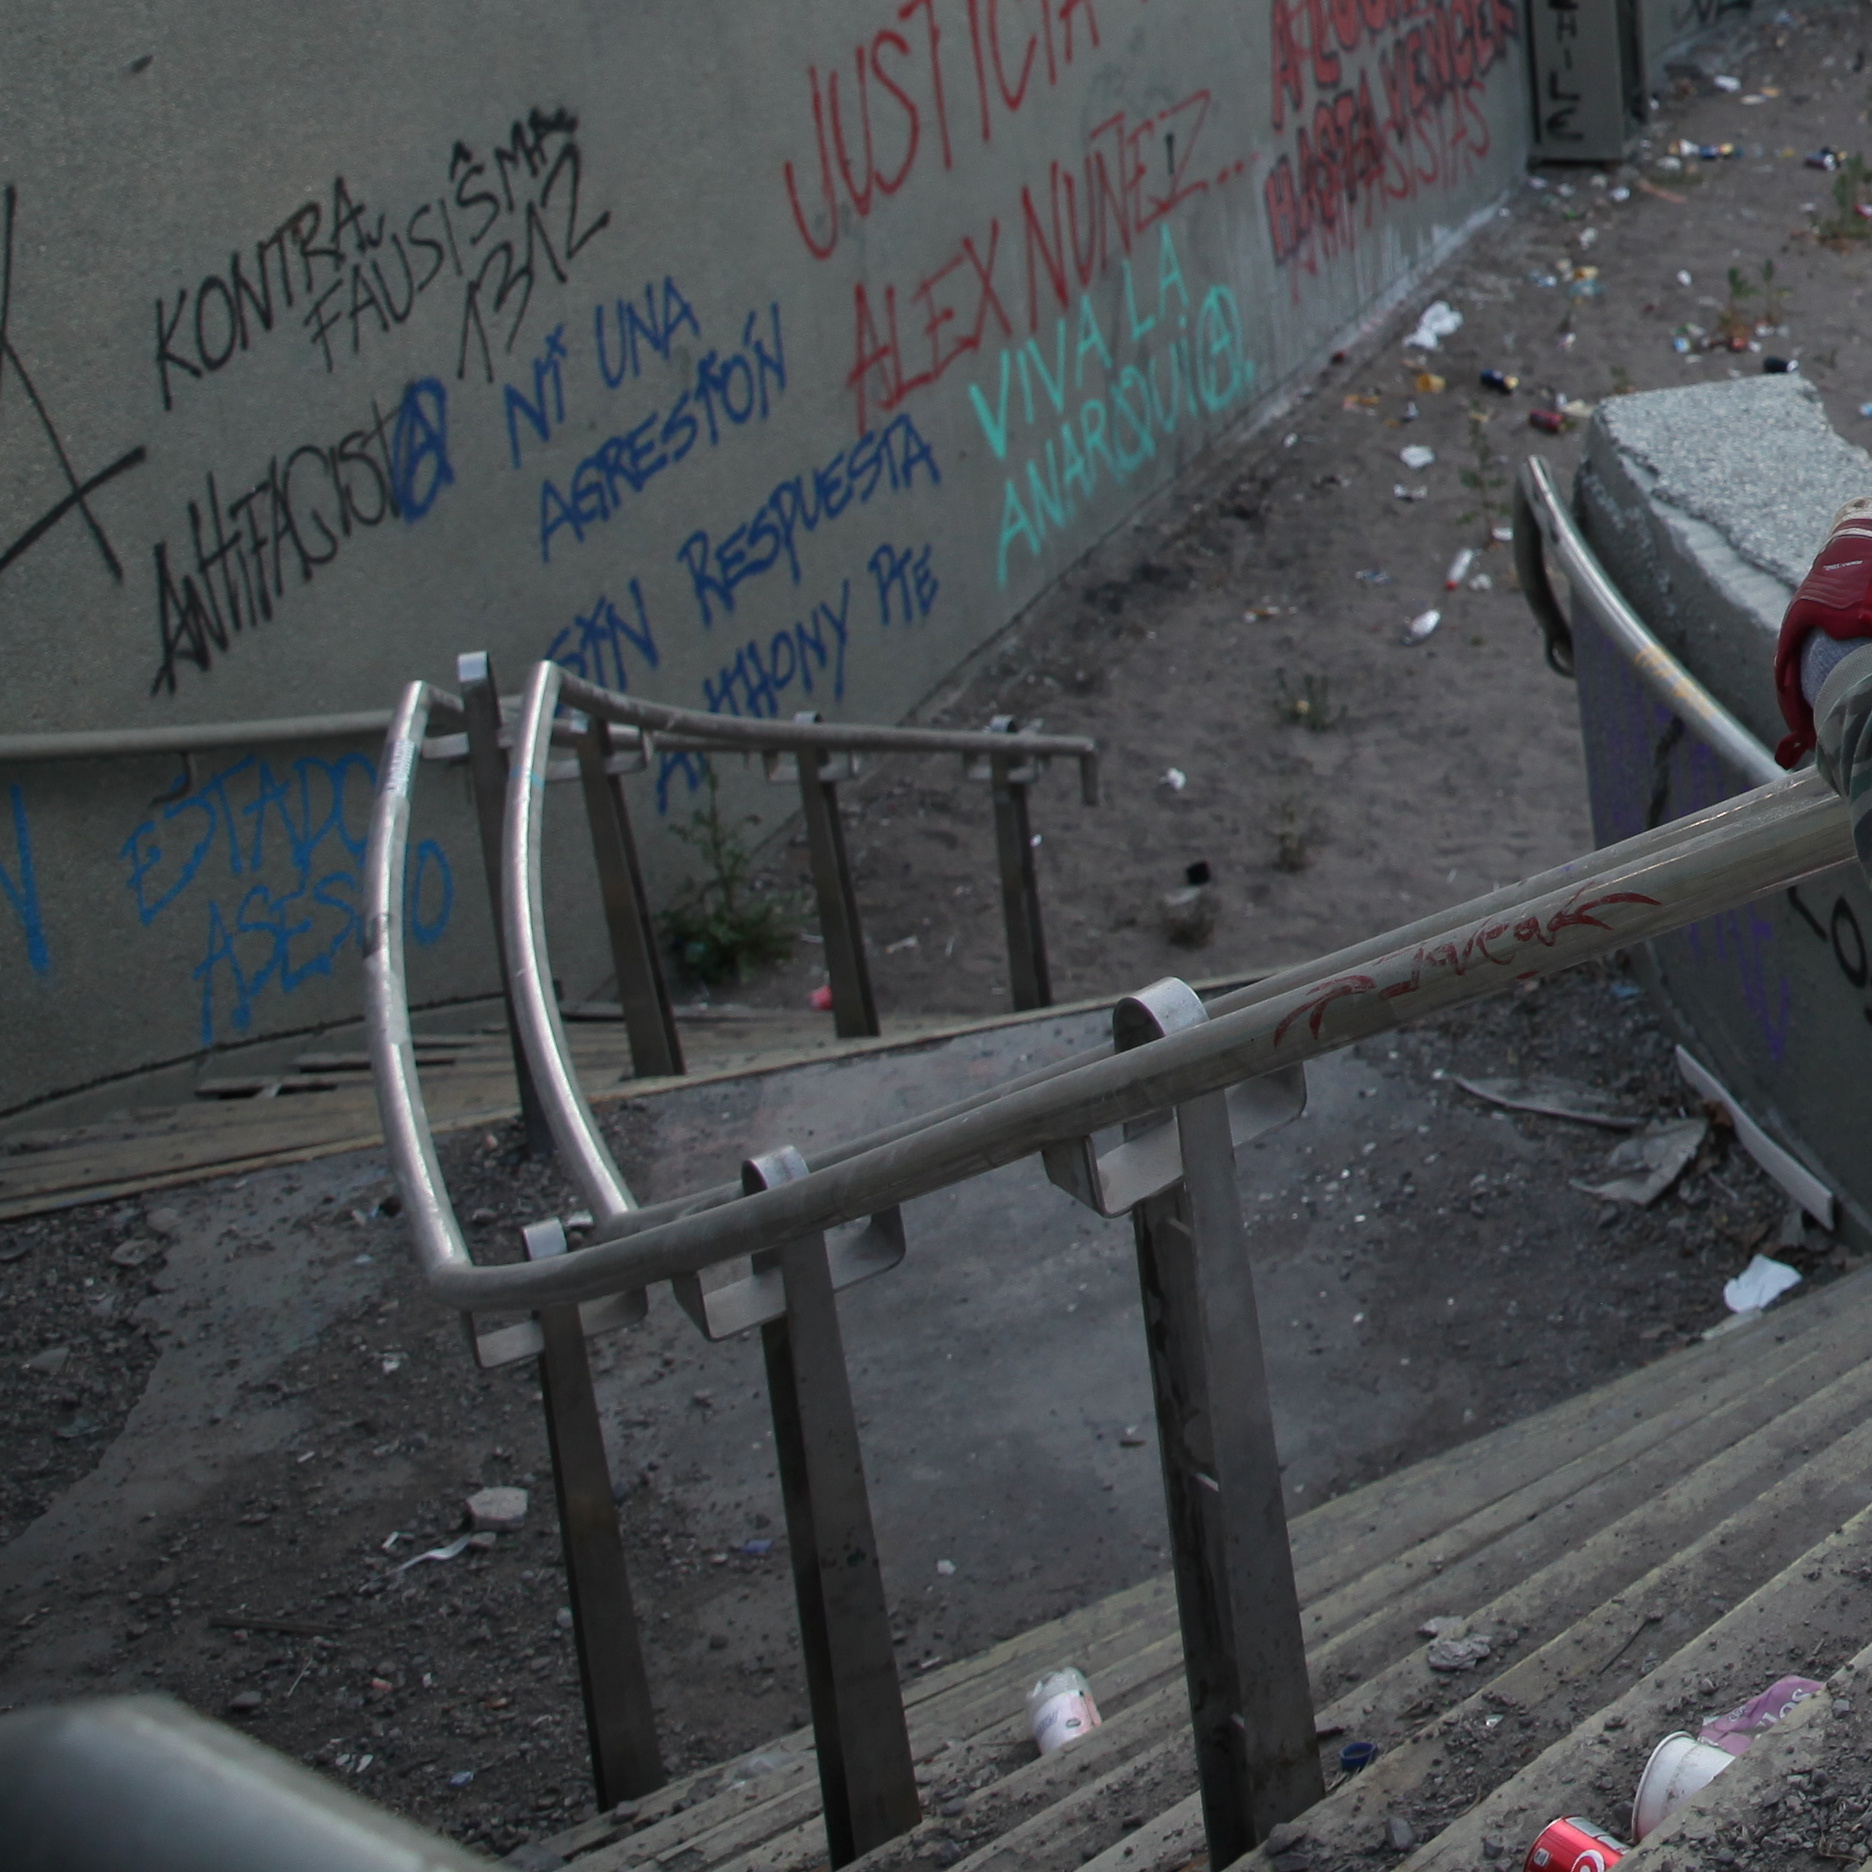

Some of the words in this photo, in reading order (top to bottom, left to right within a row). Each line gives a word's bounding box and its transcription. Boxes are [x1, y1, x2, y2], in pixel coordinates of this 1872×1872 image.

[594, 274, 700, 389] UNA
[847, 216, 1014, 439] ALEX
[970, 295, 1112, 460] VIVA
[1121, 223, 1190, 342] LA
[677, 412, 943, 630] RESPUESTA
